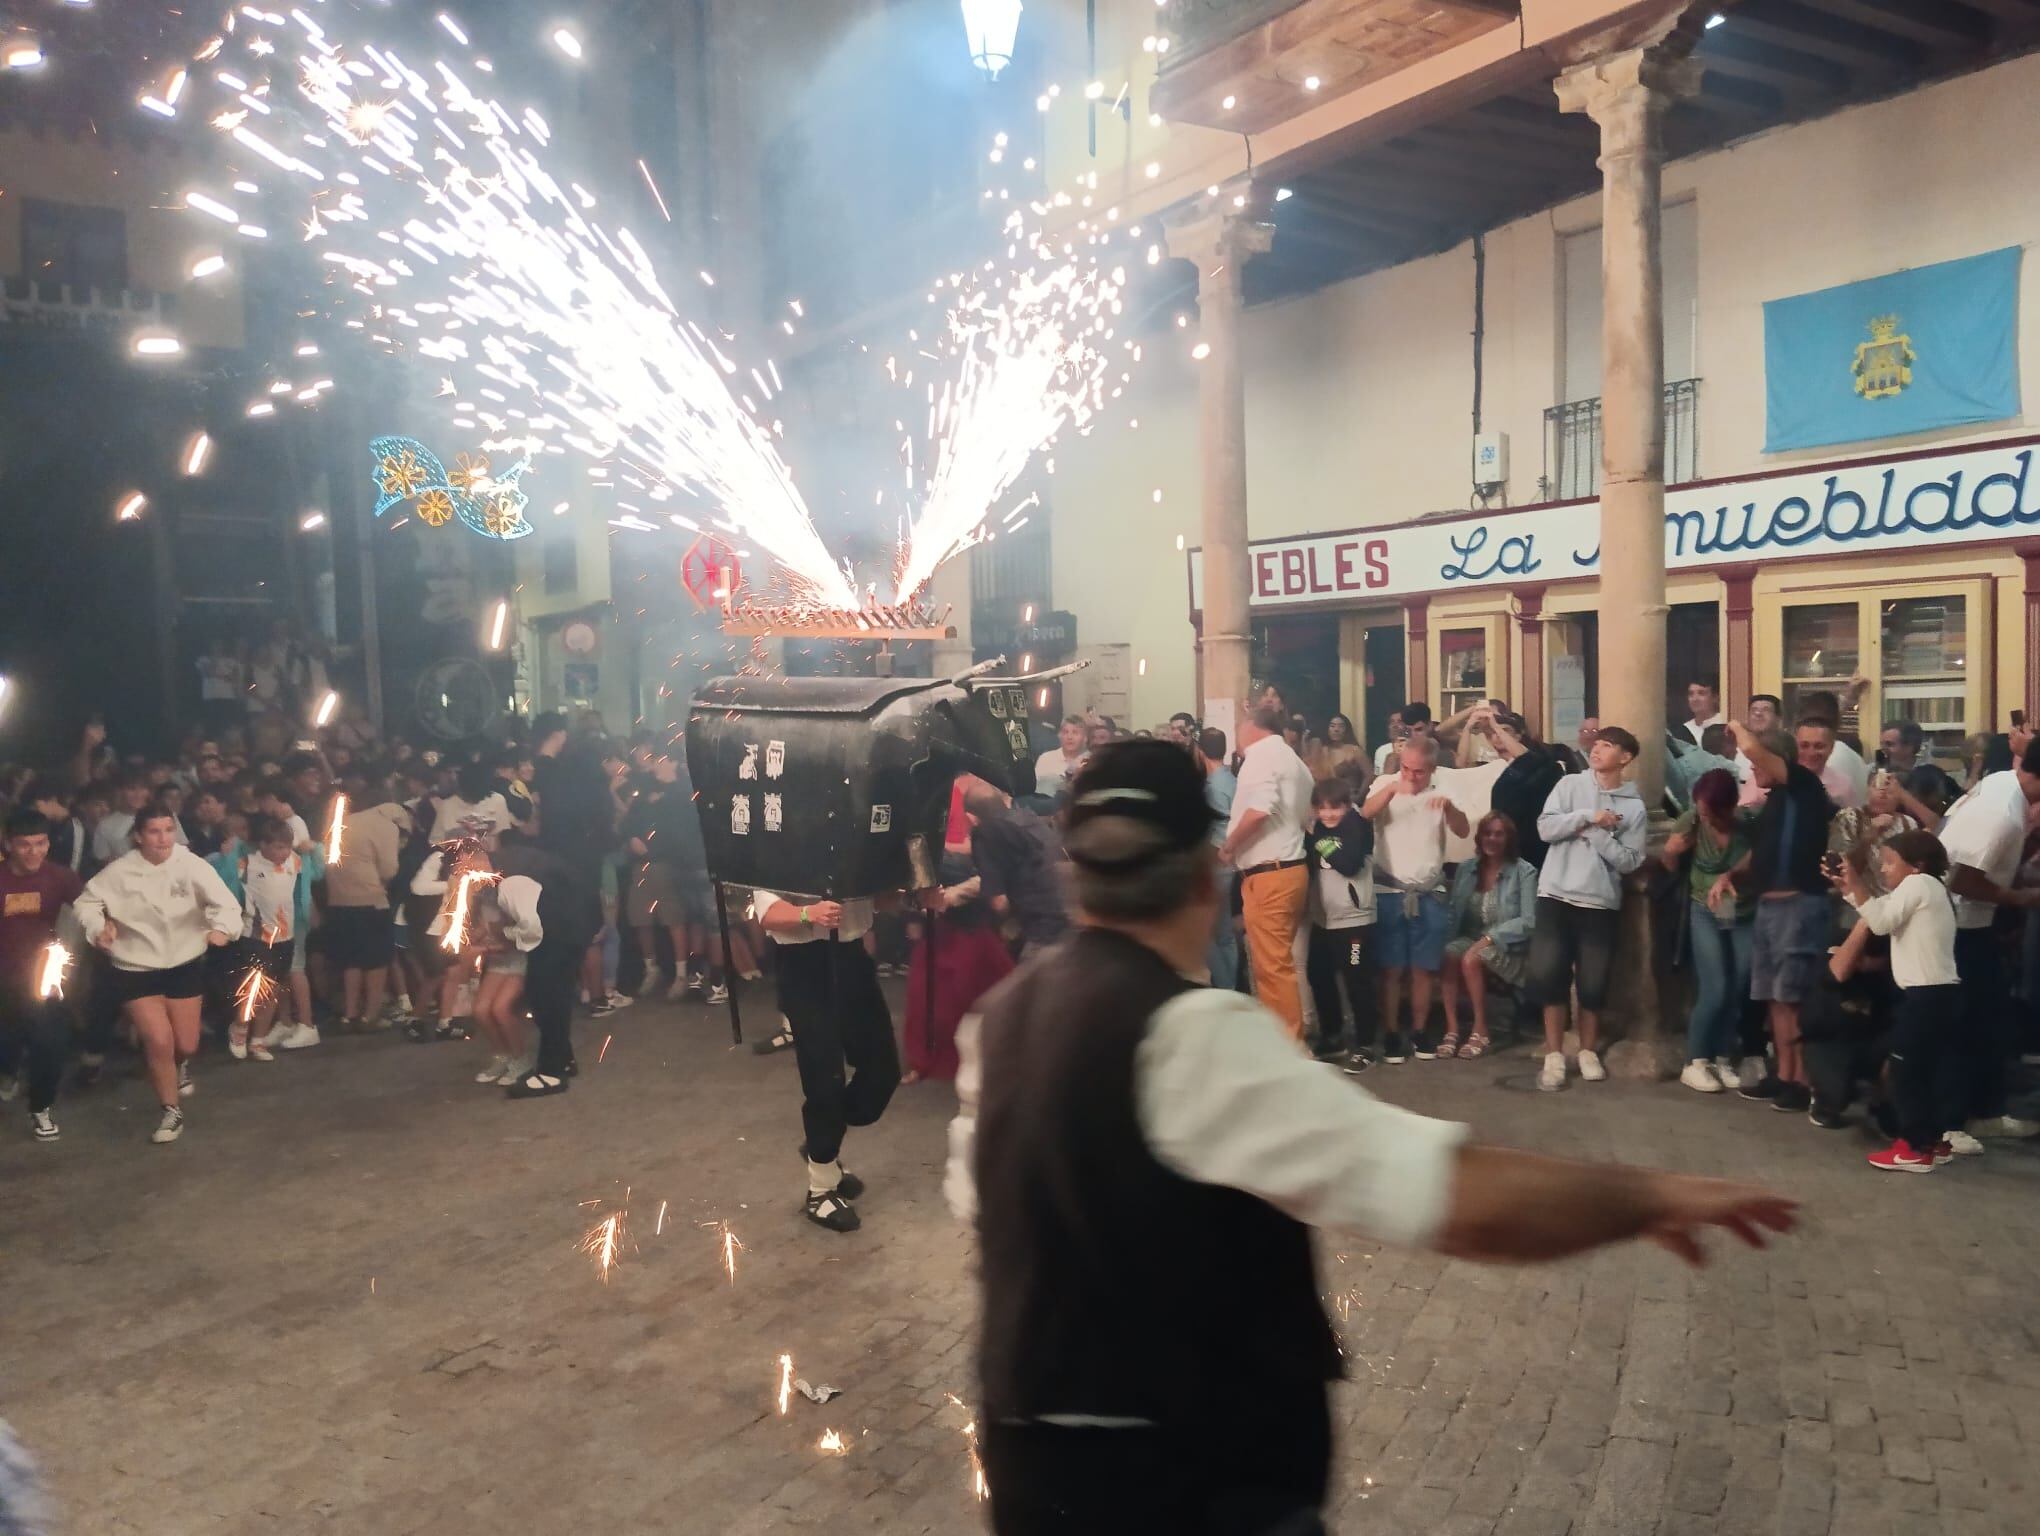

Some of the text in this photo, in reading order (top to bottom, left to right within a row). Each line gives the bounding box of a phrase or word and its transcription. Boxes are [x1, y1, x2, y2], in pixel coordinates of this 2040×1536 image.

[1441, 450, 2040, 580] La mueblad
[1248, 539, 1389, 597] EBLES
